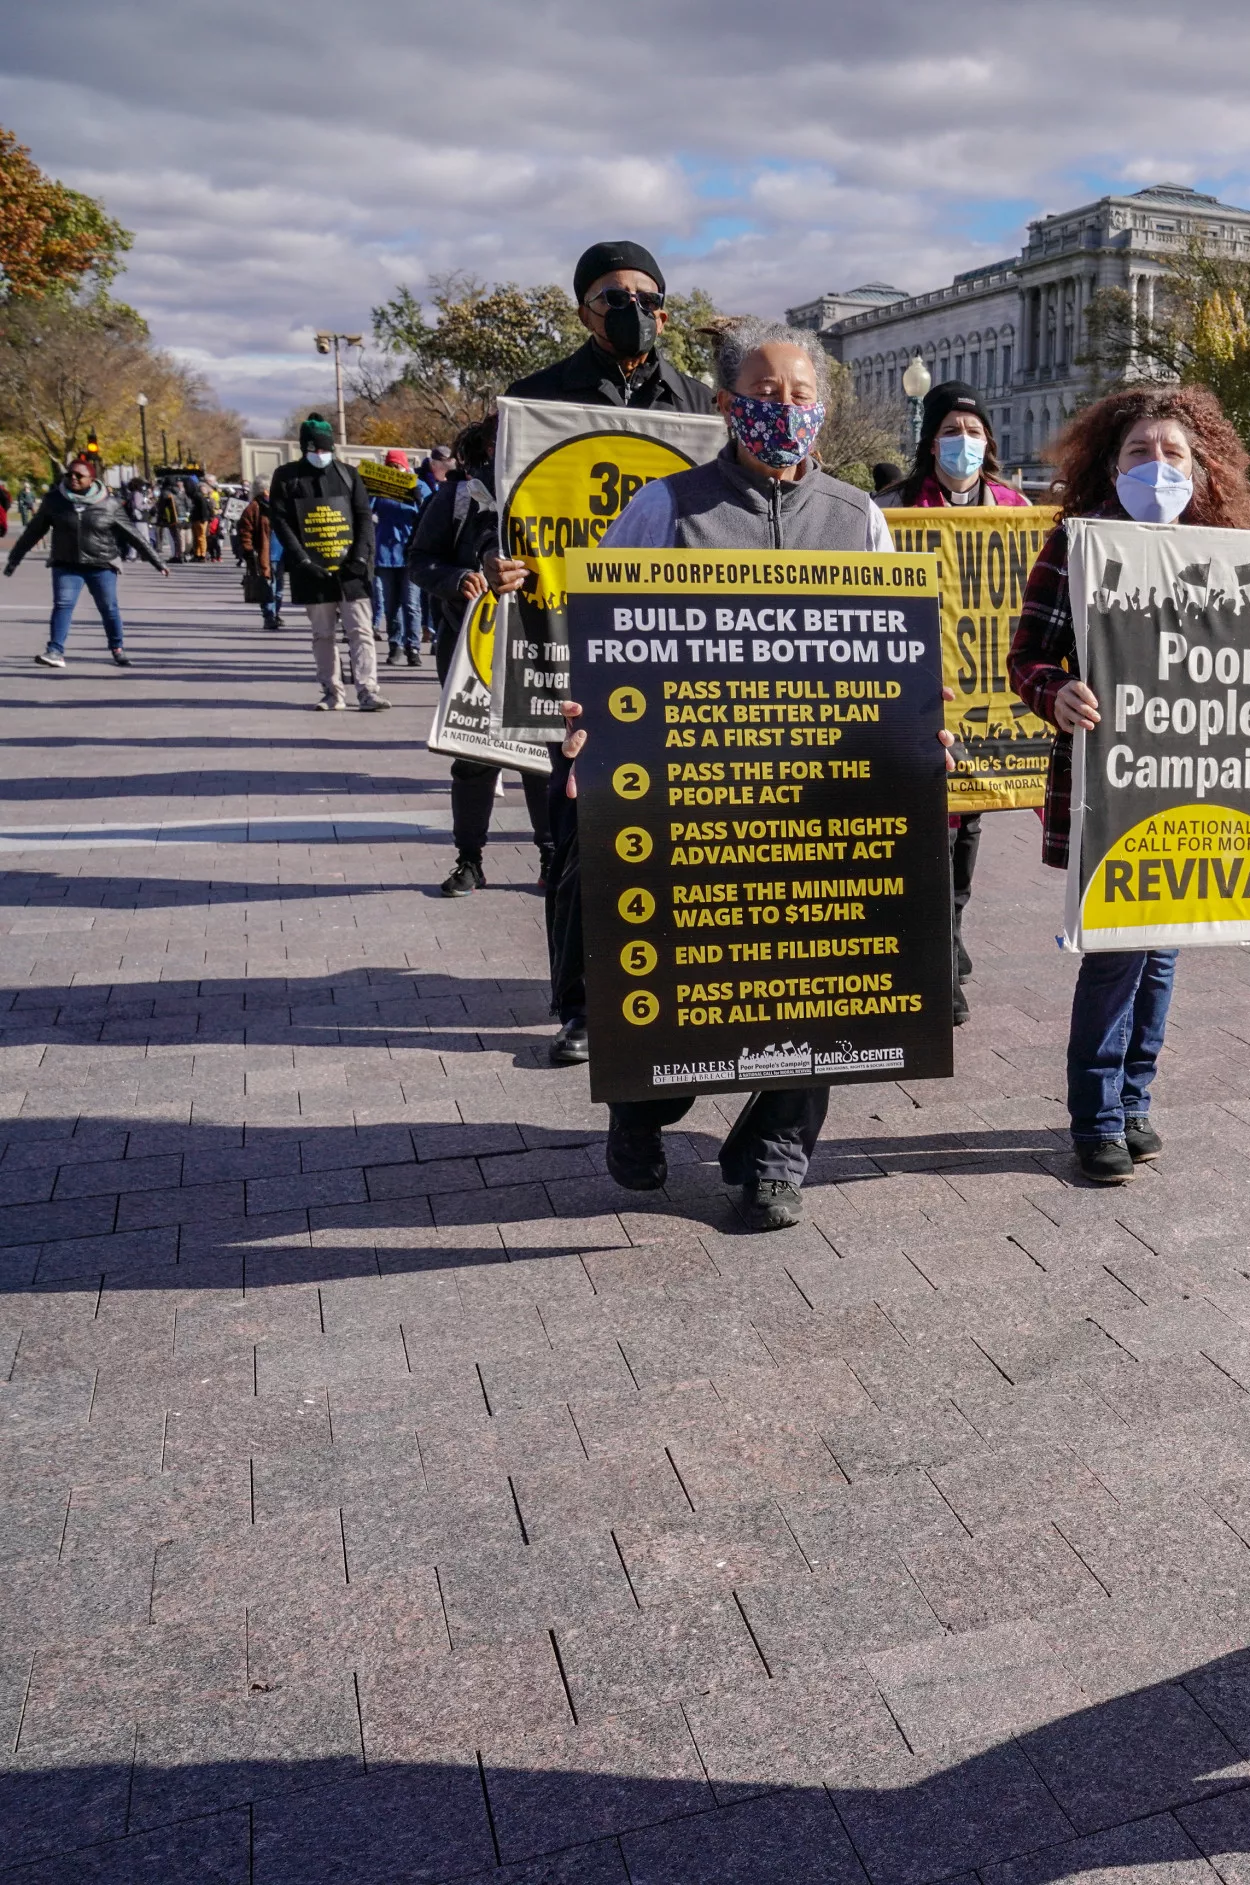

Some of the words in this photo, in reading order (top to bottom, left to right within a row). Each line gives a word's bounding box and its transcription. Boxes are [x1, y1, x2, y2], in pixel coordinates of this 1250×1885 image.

[589, 462, 661, 516] 3R
[510, 516, 614, 559] RECONS
[586, 563, 927, 588] WWW.POORPEOPLESCAMPAIGN.ORG
[956, 530, 1051, 609] WON'
[613, 607, 707, 631] BUILD
[715, 608, 797, 632] BACK
[804, 609, 908, 632] BETTER
[512, 639, 538, 660] It's
[587, 639, 679, 663] FROM
[685, 639, 744, 663] THE
[752, 639, 879, 663] BOTTOM
[887, 641, 925, 663] UP
[663, 681, 721, 699] PASS
[726, 681, 770, 699] THE
[775, 681, 830, 699] FULL
[835, 681, 901, 699] BUILD
[620, 695, 637, 713] 1
[665, 705, 728, 723] BACK
[733, 704, 815, 722] BETTER
[820, 704, 879, 722] PLAN
[448, 710, 479, 729] Poor
[449, 731, 491, 747] NATIONAL
[493, 740, 514, 752] CALL
[515, 744, 527, 754] for
[528, 747, 550, 759] MOR
[665, 729, 696, 747] AS
[701, 729, 719, 747] A
[724, 728, 785, 746] FIRST
[790, 728, 842, 746] STEP
[667, 763, 725, 781] PASS
[730, 762, 774, 780] THE
[779, 761, 824, 779] FOR
[828, 761, 871, 778] THE
[949, 756, 1002, 775] ople's
[622, 772, 641, 792] 2
[960, 782, 986, 792] CALL
[1005, 778, 1043, 790] MORAL
[669, 786, 754, 806] PEOPLE
[759, 785, 803, 804] ACT
[670, 821, 728, 841] PASS
[732, 819, 822, 839] VOTING
[828, 817, 908, 837] RIGHTS
[1146, 821, 1158, 835] A
[625, 833, 644, 857] 3
[670, 842, 848, 866] ADVANCEMENT
[852, 841, 895, 860] ACT
[1124, 838, 1172, 853] CALL
[1177, 837, 1212, 852] FOR
[673, 883, 738, 904] RAISE
[743, 882, 786, 900] THE
[792, 877, 904, 899] MINIMUM
[626, 893, 645, 917] 4
[672, 907, 743, 928] WAGE
[748, 905, 780, 925] TO
[785, 902, 866, 924] $15/HR
[630, 946, 647, 970] 5
[675, 945, 723, 965] END
[728, 942, 772, 962] THE
[777, 936, 900, 960] FILIBUSTER
[677, 982, 734, 1003] PASS
[739, 973, 893, 999] PROTECTIONS
[632, 995, 650, 1018] 6
[677, 1006, 724, 1026] FOR
[728, 1003, 771, 1023] ALL
[776, 994, 923, 1020] IMMIGRANTS
[780, 1060, 810, 1068] Campaign
[860, 1047, 904, 1062] CENTER
[653, 1060, 735, 1076] REPAIRERS
[654, 1076, 668, 1084] OF
[700, 1071, 734, 1080] BREACH
